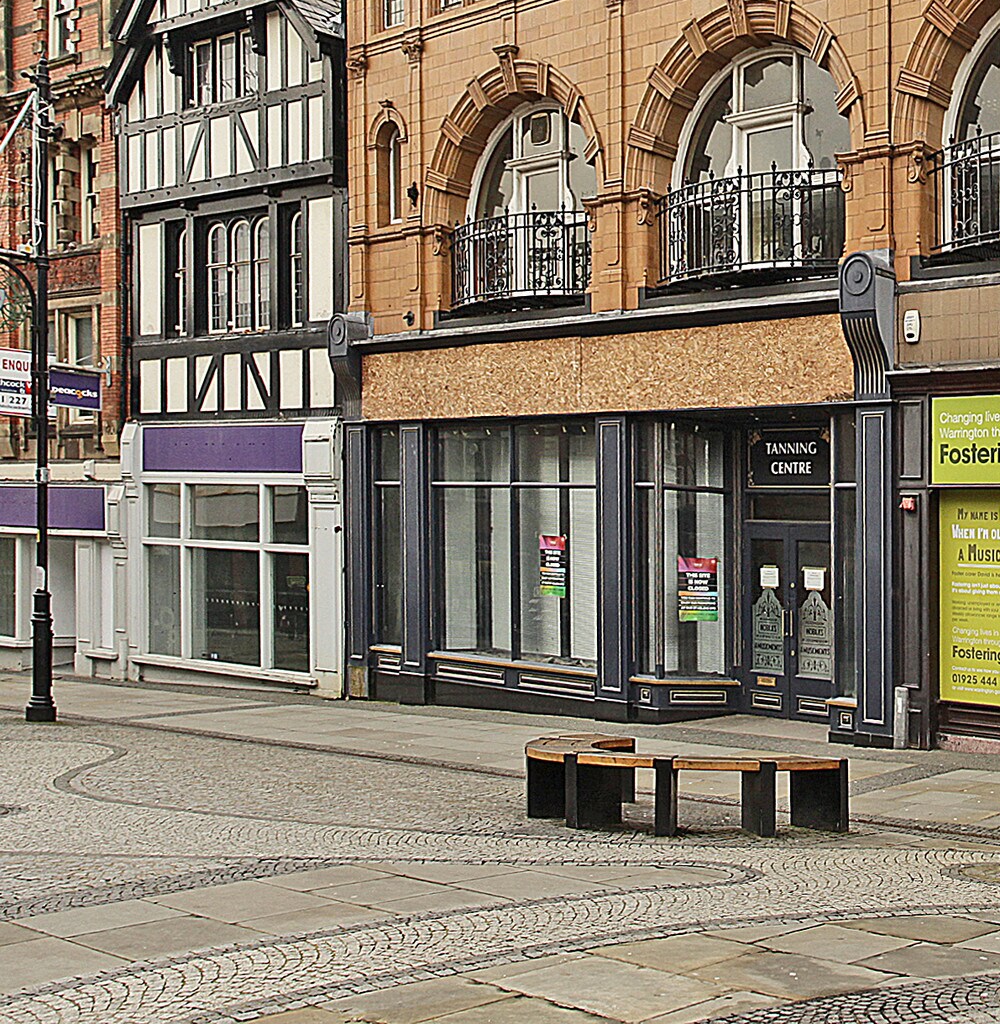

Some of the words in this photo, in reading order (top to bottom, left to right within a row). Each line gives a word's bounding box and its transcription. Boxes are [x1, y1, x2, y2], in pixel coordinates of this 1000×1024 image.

[51, 386, 98, 399] peacocks
[9, 396, 27, 405] 227
[939, 411, 983, 426] Changing
[939, 427, 989, 441] Warrington
[766, 442, 817, 455] TANNING
[771, 462, 812, 474] CENTRE
[958, 548, 964, 561] A
[952, 626, 979, 637] Changing
[980, 628, 992, 636] lives
[993, 629, 1000, 637] in
[952, 635, 983, 646] Warrington
[952, 673, 978, 685] 01925
[980, 676, 997, 687] 444
